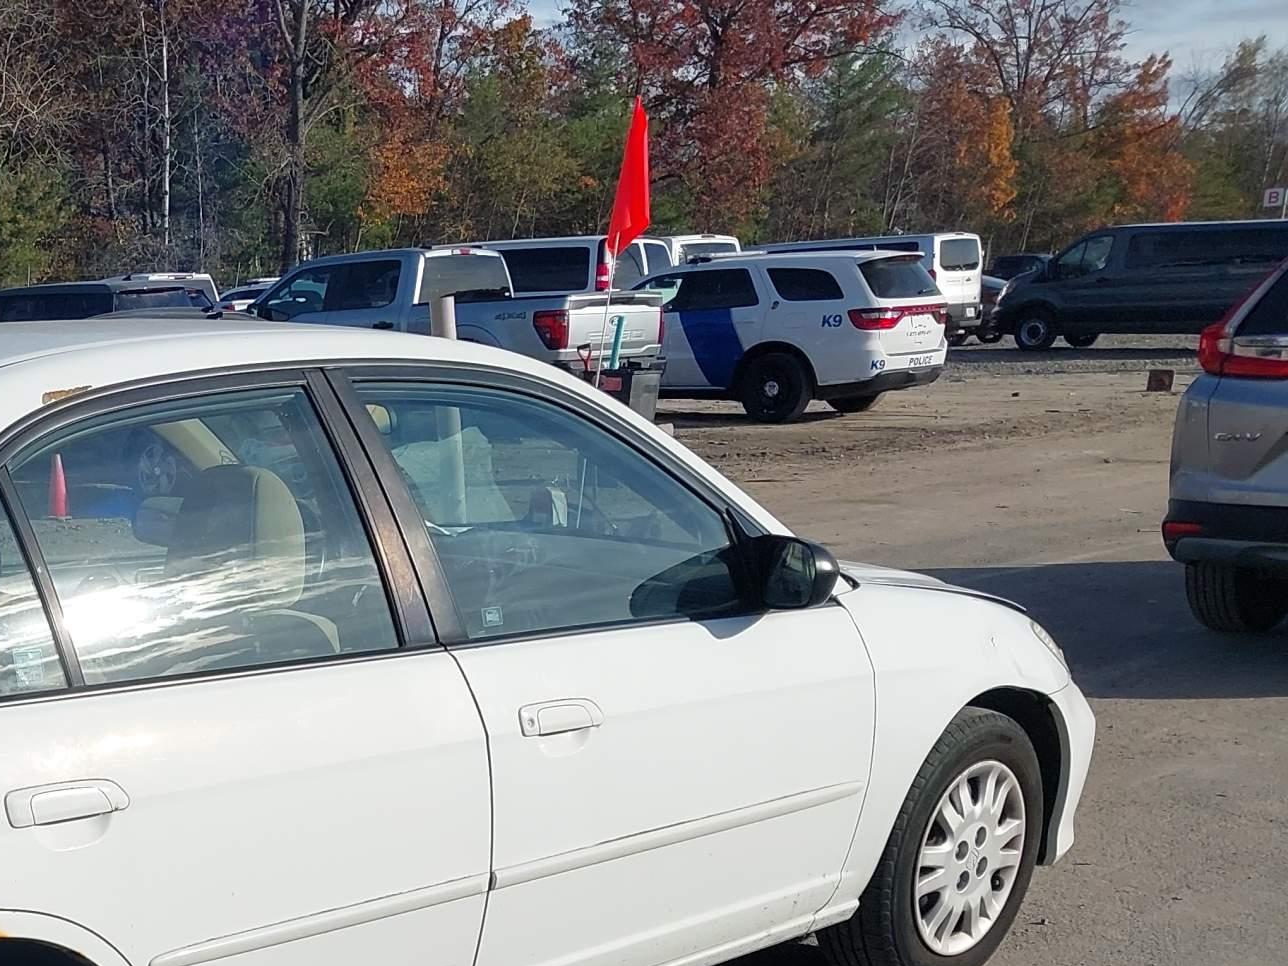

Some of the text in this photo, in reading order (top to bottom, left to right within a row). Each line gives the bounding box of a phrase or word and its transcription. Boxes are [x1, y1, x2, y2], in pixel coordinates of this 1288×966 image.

[1269, 191, 1279, 204] B
[822, 314, 843, 328] K9
[871, 360, 885, 370] K9
[909, 356, 932, 366] POLICE
